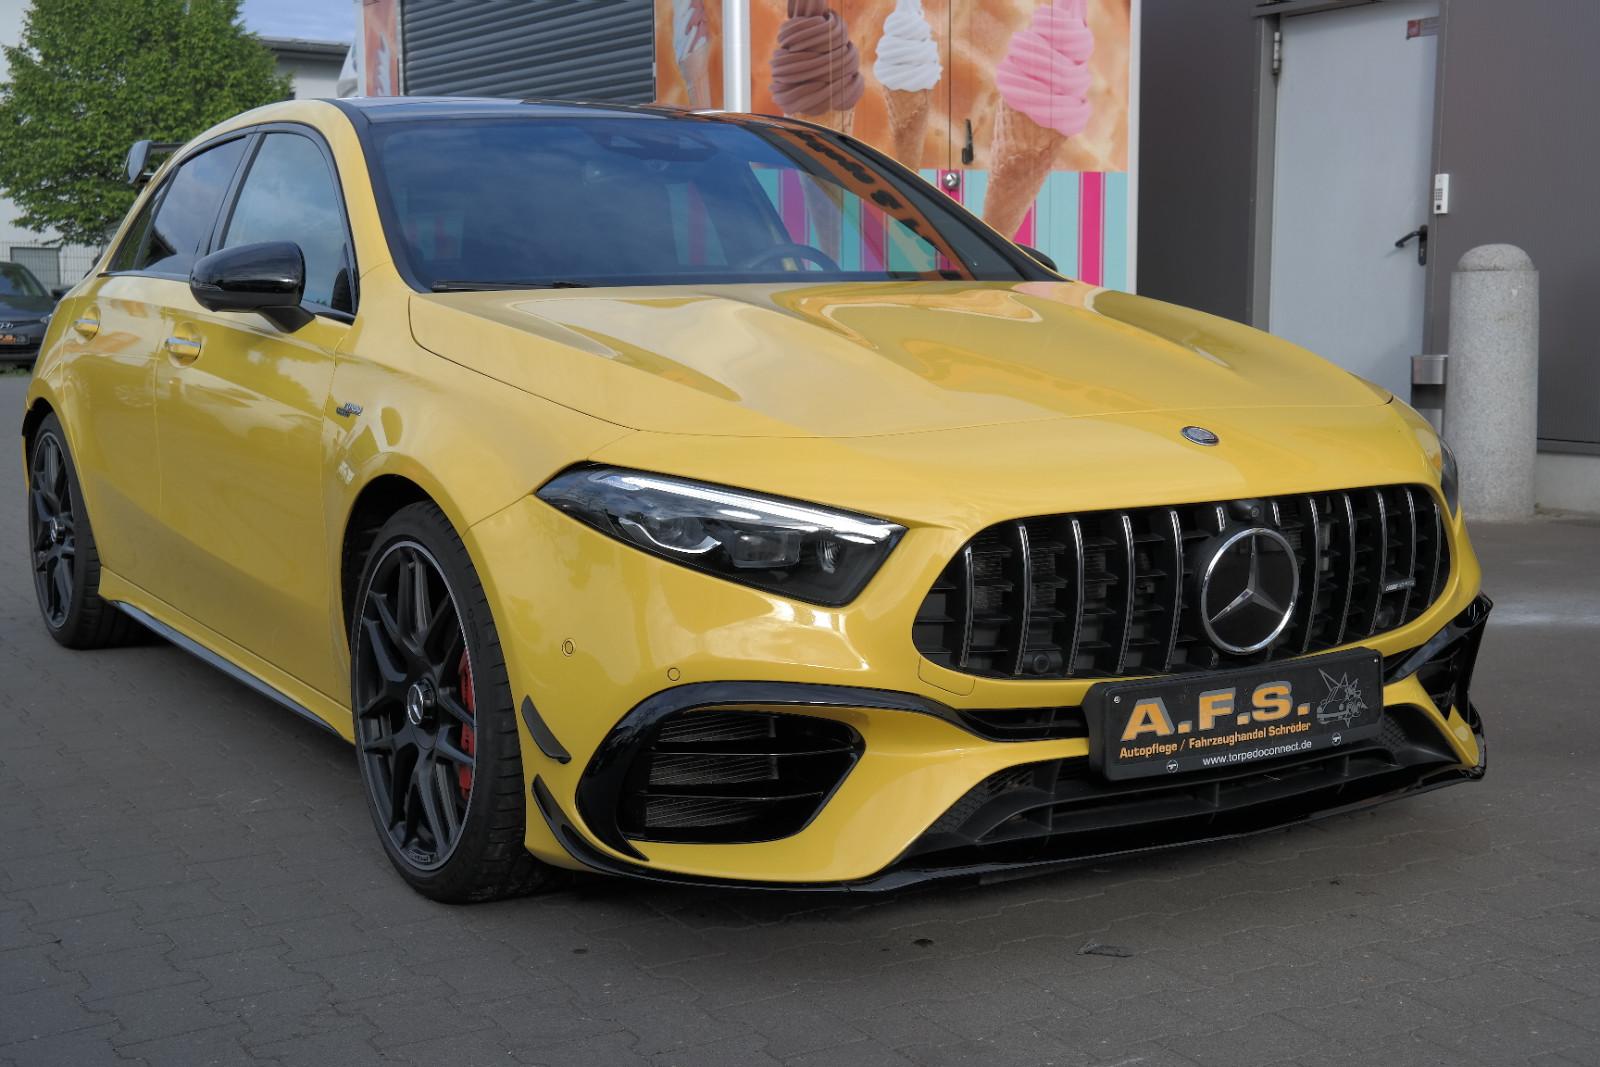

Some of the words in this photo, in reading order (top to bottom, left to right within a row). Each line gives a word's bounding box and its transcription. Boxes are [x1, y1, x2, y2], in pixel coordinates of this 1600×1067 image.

[1120, 681, 1310, 742] A.F.S.
[1120, 743, 1177, 759] Autopflege
[1189, 727, 1267, 748] Fahrzeughandel
[1202, 740, 1312, 766] www.torpedoconnect.de
